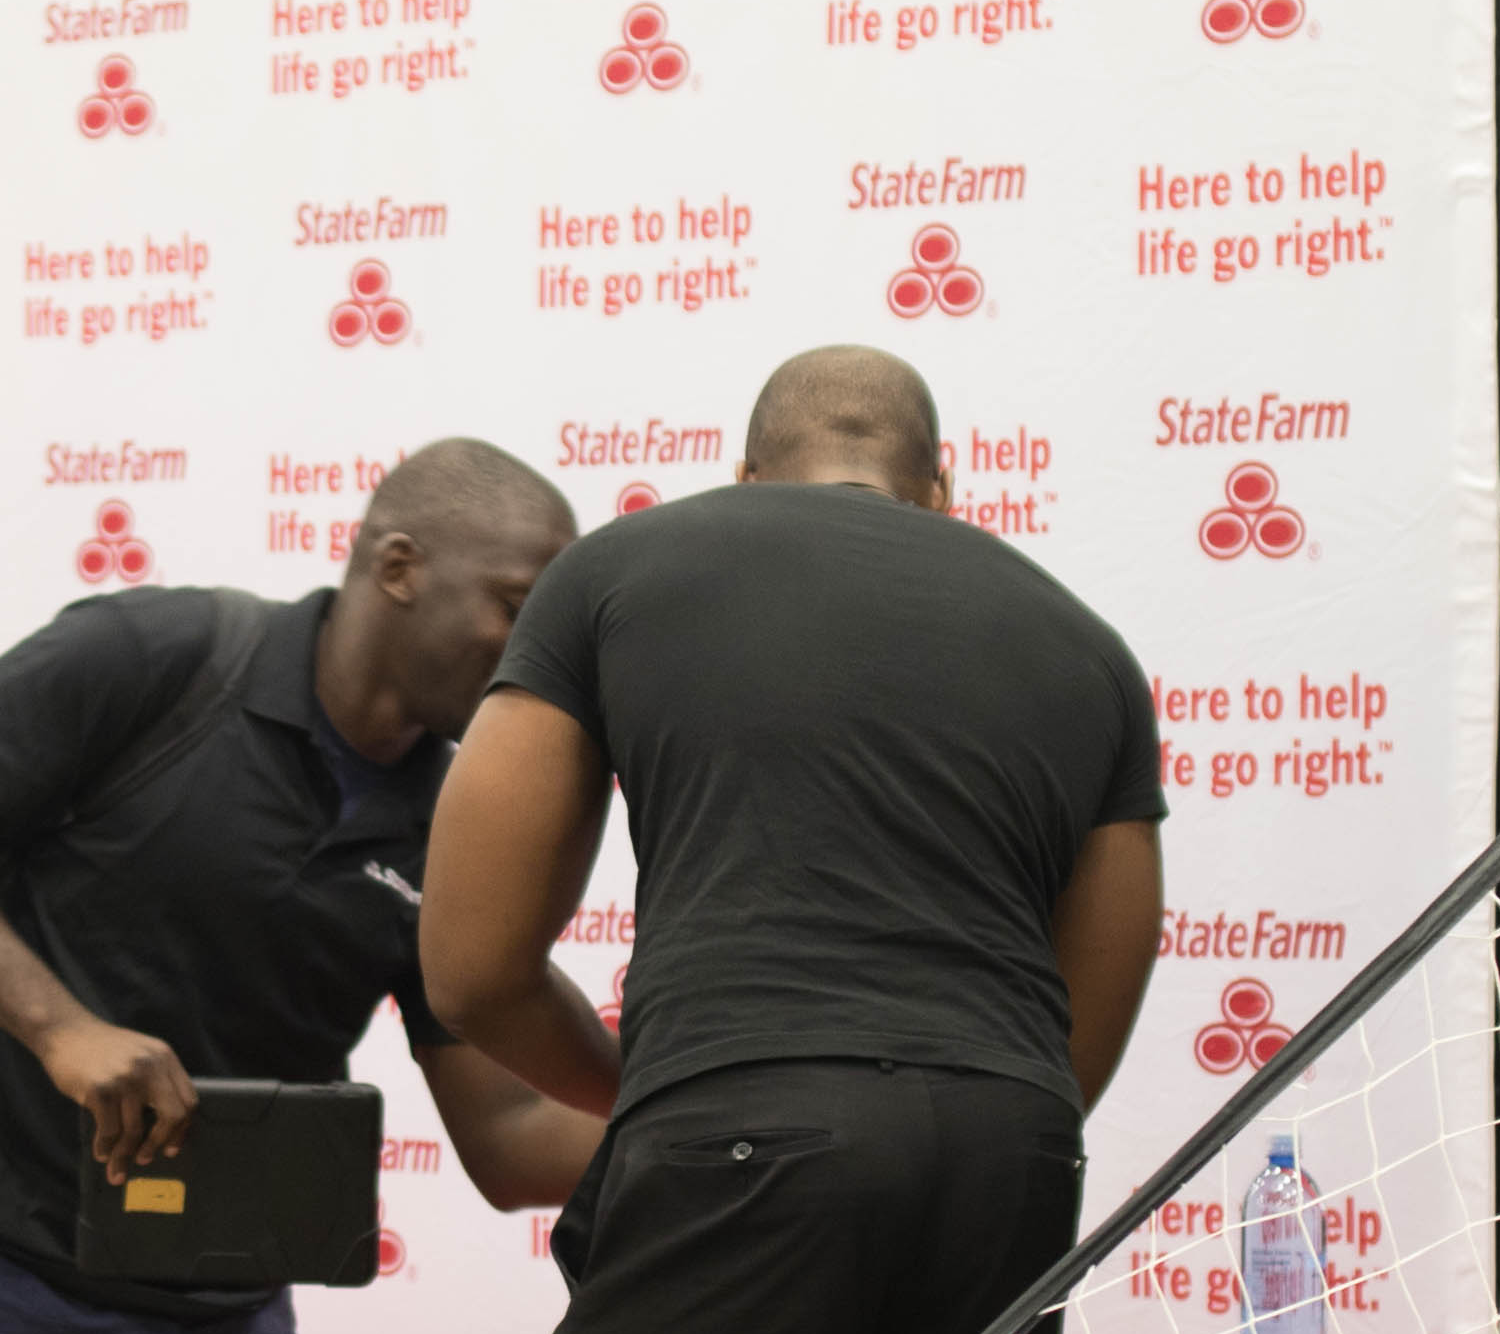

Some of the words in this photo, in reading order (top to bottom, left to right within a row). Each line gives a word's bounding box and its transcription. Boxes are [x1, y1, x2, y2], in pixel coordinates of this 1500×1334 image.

[827, 0, 881, 44] life
[895, 6, 938, 52] go
[271, 53, 320, 94] life
[330, 56, 370, 102] go
[1138, 166, 1231, 211] Here
[1244, 162, 1284, 204] to
[1299, 150, 1385, 206] help
[537, 208, 620, 250] Here
[629, 206, 666, 246] to
[676, 192, 753, 248] help
[23, 248, 94, 283] Here
[102, 244, 134, 278] to
[143, 237, 210, 279] help
[1137, 229, 1197, 276] life
[1212, 236, 1260, 284] go
[537, 264, 589, 310] life
[601, 271, 644, 318] go
[25, 302, 68, 338] life
[79, 304, 115, 347] go
[268, 453, 342, 493] Here
[355, 454, 387, 491] to
[971, 426, 1051, 481] help
[268, 511, 315, 551] life
[1244, 677, 1284, 721] to
[1299, 671, 1387, 730] help
[1160, 739, 1195, 786] fe
[1210, 751, 1258, 798] go
[1134, 1186, 1224, 1237] ere
[1323, 1195, 1382, 1256] elp
[1131, 1251, 1192, 1301] life
